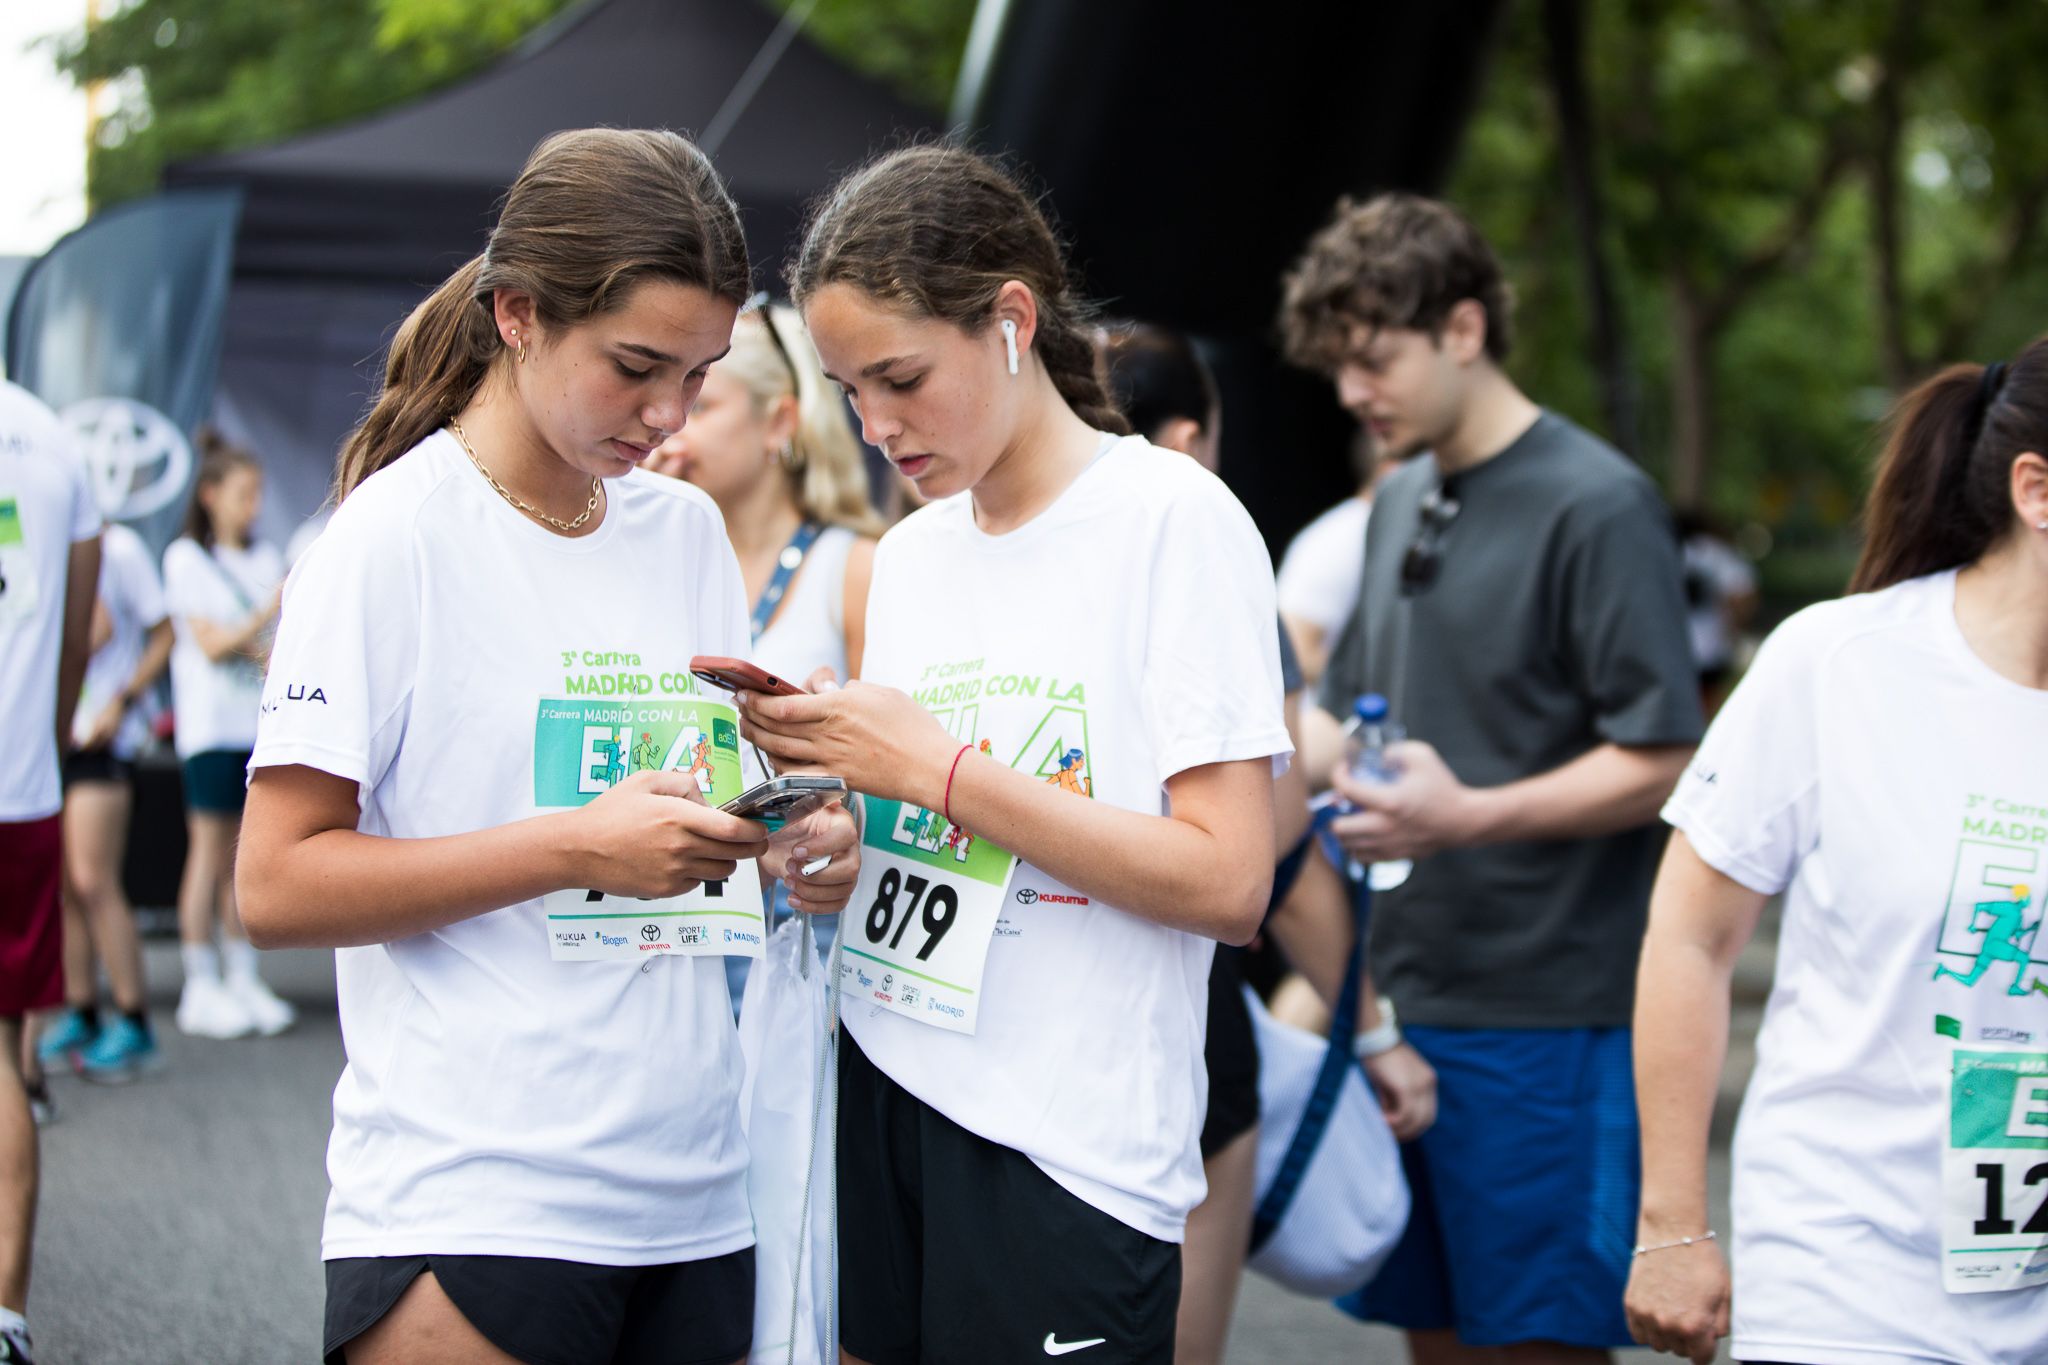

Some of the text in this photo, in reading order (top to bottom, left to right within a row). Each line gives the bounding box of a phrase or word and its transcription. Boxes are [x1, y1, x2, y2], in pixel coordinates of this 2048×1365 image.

[985, 675, 1041, 697] CON
[1046, 679, 1085, 705] LA
[549, 709, 581, 720] Carrera
[584, 709, 633, 723] MADRID
[638, 710, 673, 722] CON
[678, 710, 699, 722] LA
[865, 867, 959, 962] 879
[678, 926, 700, 934] SPORT
[602, 935, 629, 947] Biogen
[681, 934, 699, 944] LIFE
[733, 932, 761, 945] MADRID
[901, 994, 914, 1004] LIFE
[934, 1002, 965, 1018] MADRID
